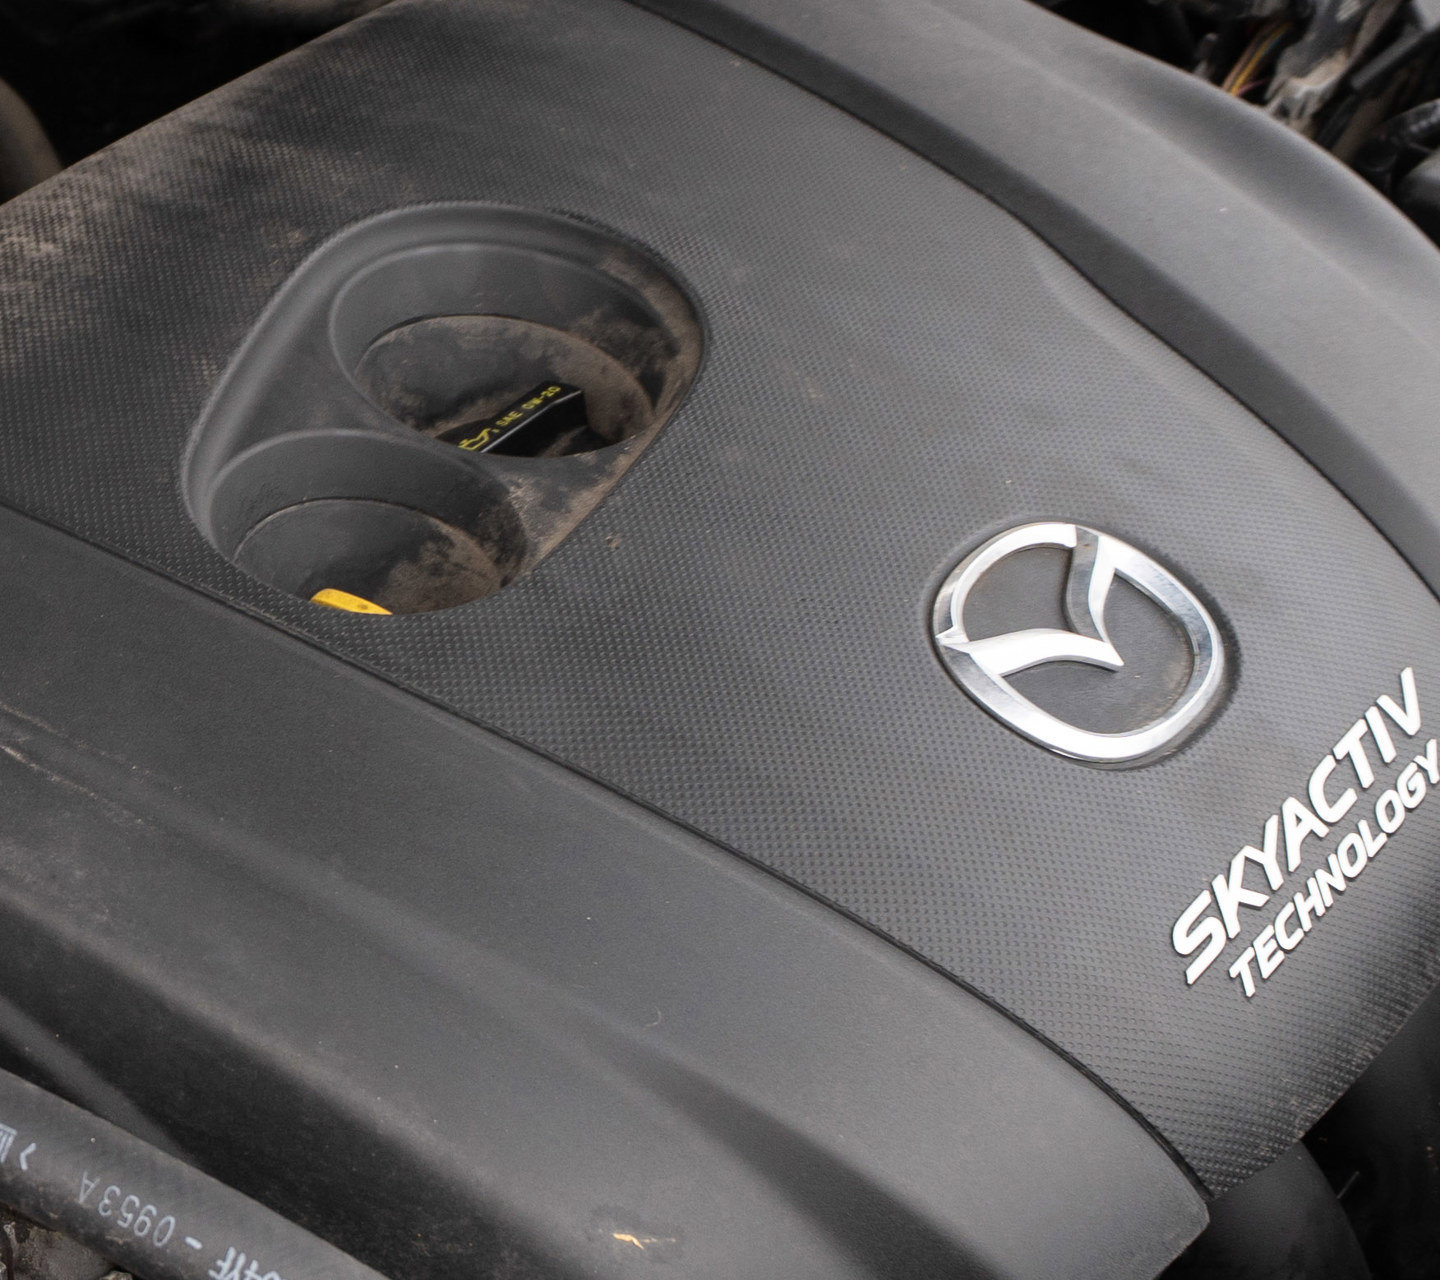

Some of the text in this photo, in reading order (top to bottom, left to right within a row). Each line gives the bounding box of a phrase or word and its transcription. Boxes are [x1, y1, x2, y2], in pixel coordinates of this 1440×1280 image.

[495, 410, 523, 427] SAE
[1171, 666, 1423, 986] SKYACTIV
[1228, 737, 1440, 998] TECHNOLOGY
